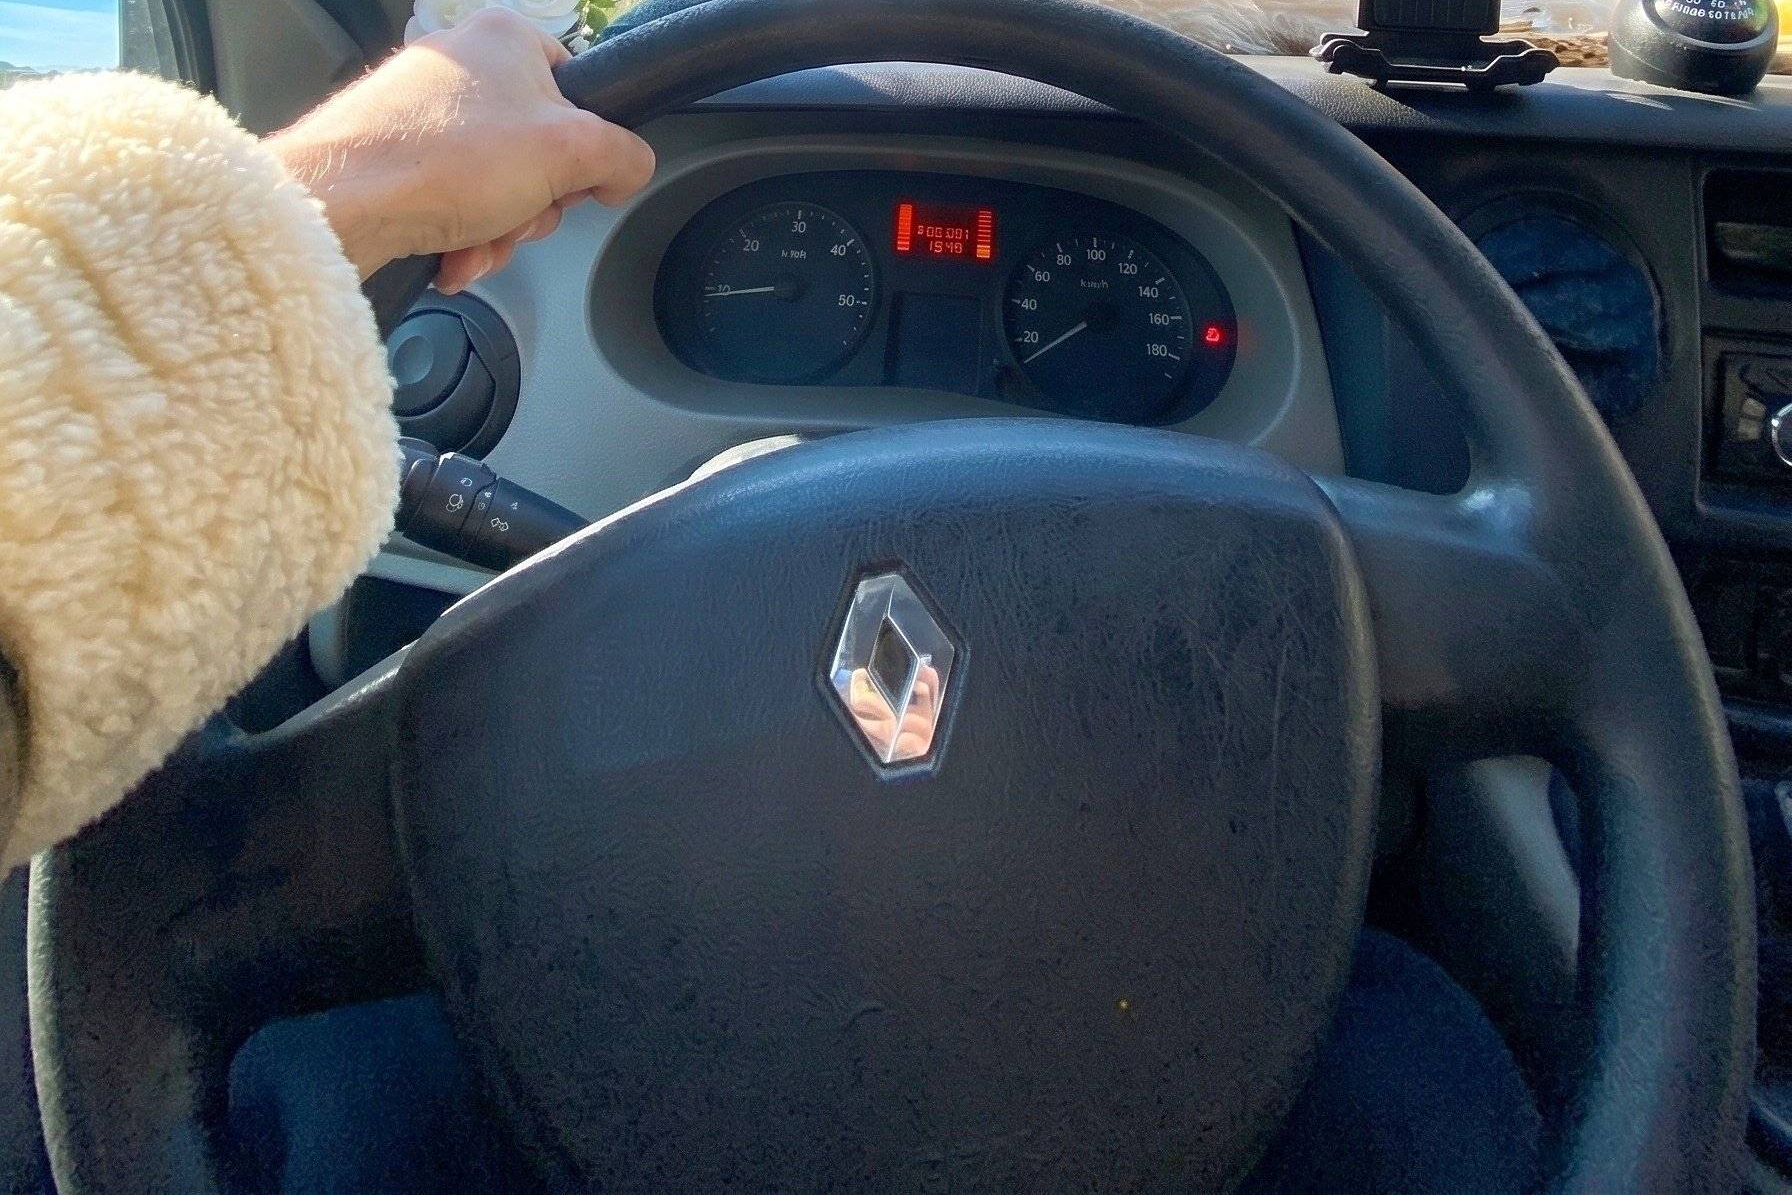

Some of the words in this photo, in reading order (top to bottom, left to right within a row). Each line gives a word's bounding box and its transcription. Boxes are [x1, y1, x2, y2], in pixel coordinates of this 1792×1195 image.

[791, 221, 806, 233] 30
[743, 239, 760, 252] 20
[830, 244, 846, 256] 40
[1056, 254, 1072, 266] 80
[1086, 249, 1106, 261] 100
[1118, 262, 1138, 275] 120
[1034, 271, 1050, 282] 60
[1138, 286, 1159, 298] 140
[838, 295, 855, 307] 50
[1021, 298, 1037, 310] 40
[1149, 312, 1170, 325] 160
[1023, 330, 1039, 343] 20
[1146, 343, 1168, 356] 180
